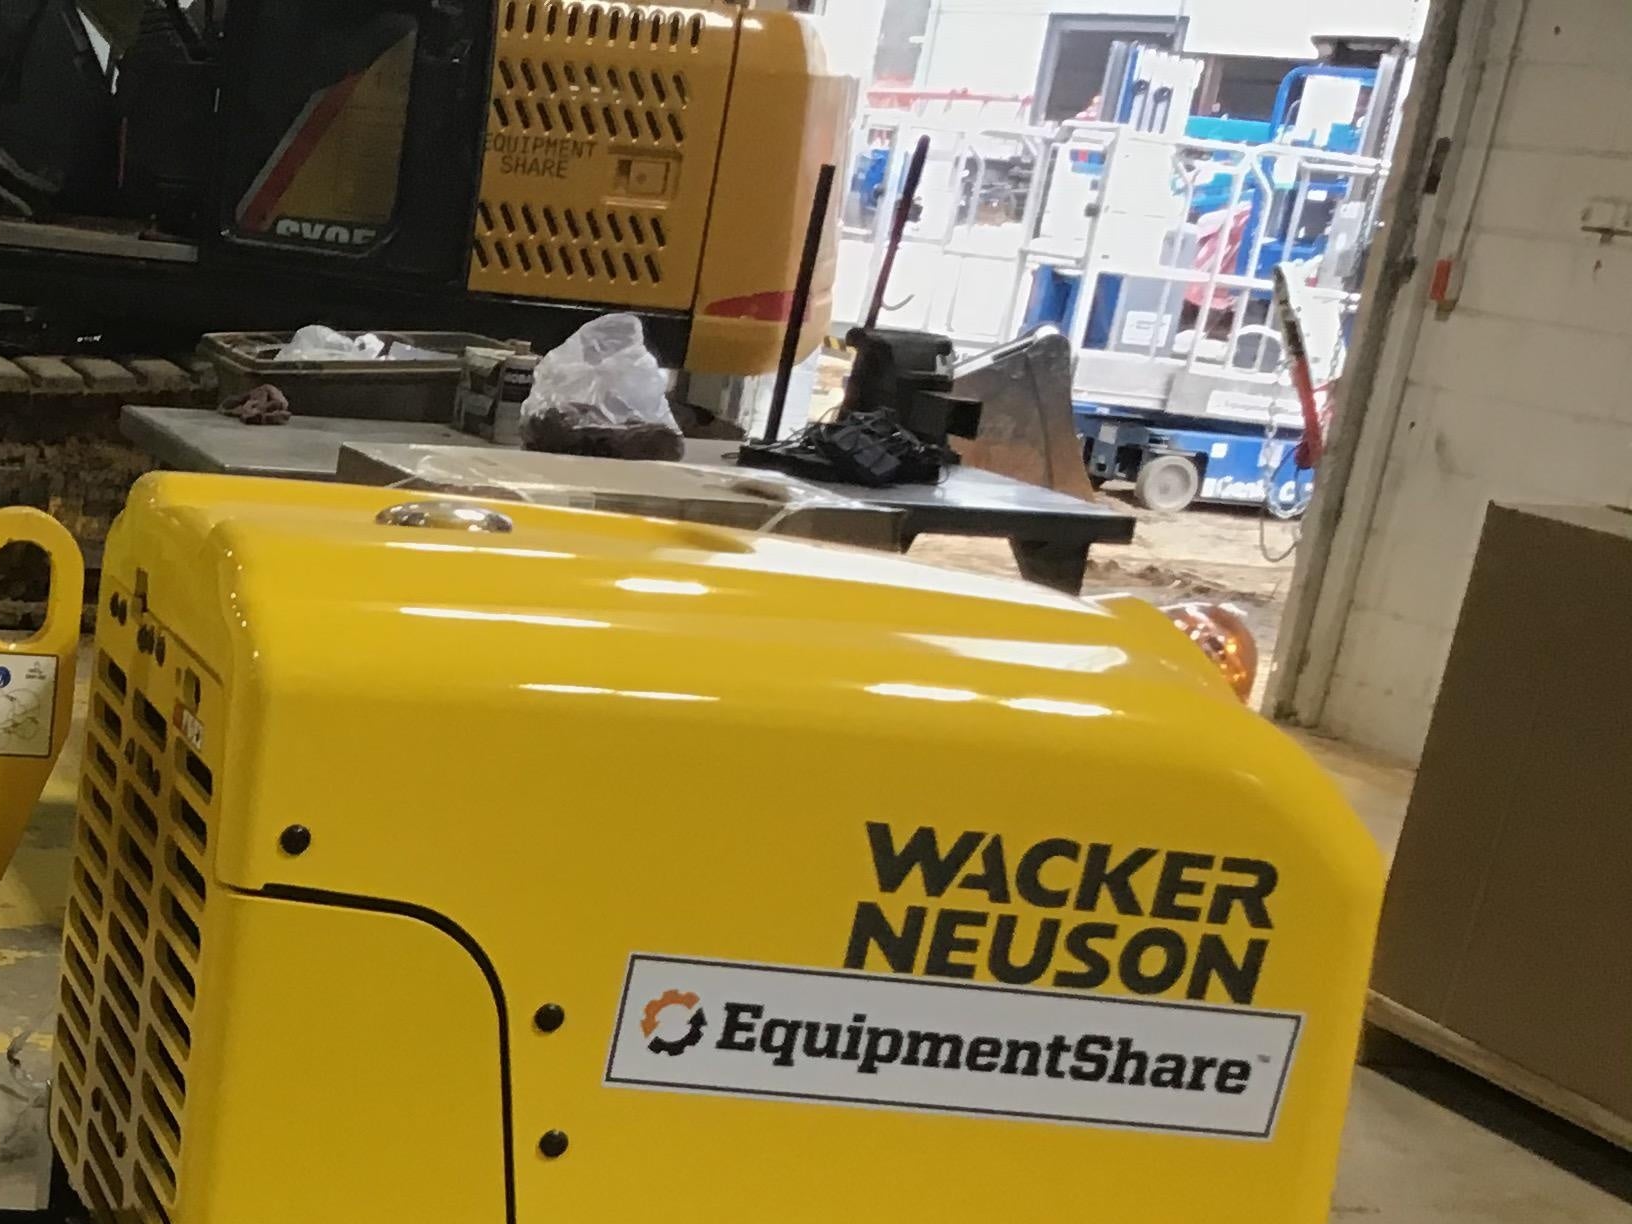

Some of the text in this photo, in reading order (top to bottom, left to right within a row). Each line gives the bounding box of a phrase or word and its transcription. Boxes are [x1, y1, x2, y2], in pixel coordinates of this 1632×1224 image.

[481, 131, 597, 158] EQUIPMENT
[500, 154, 569, 179] SHARE
[865, 821, 1279, 929] WACKER
[843, 901, 1268, 1004] NEUSON
[715, 1002, 1251, 1094] EquipmentShare
